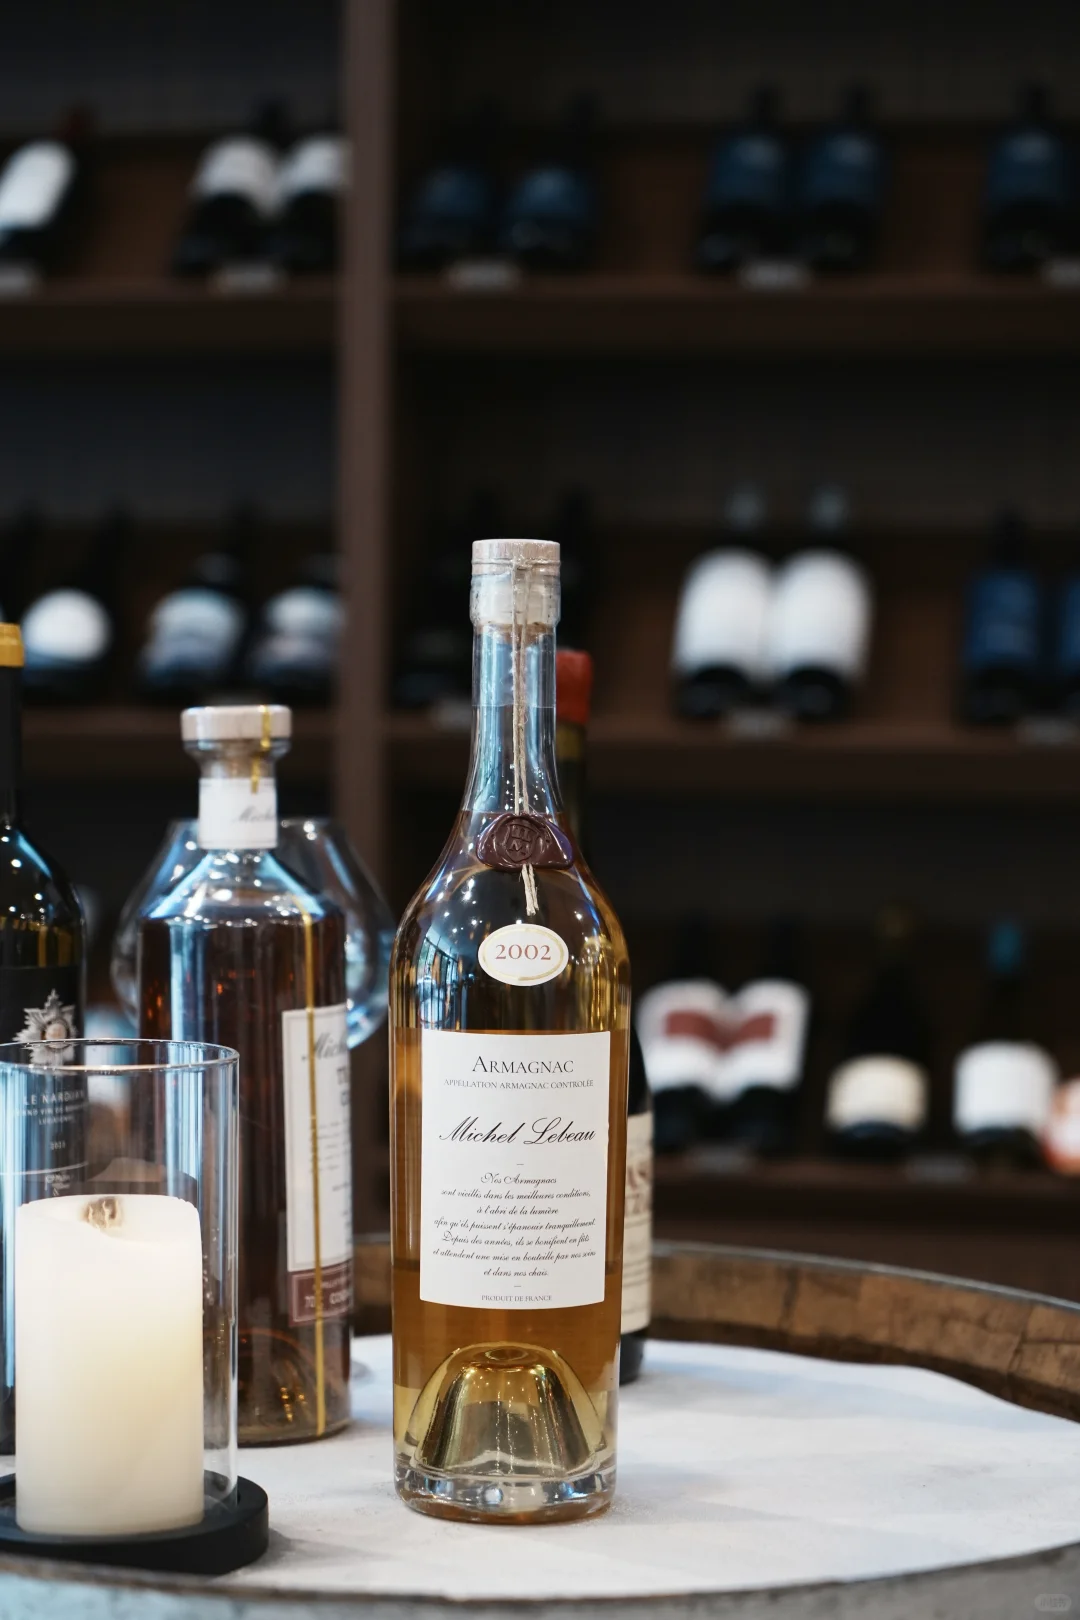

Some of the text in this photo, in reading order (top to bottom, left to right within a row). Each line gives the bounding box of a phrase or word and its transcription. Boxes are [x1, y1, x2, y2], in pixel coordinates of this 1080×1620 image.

[495, 944, 551, 960] 2002
[472, 1055, 574, 1074] ARMAGNAC
[499, 1081, 550, 1090] ARMAGNAC
[438, 1115, 596, 1145] Michel Lebeau
[480, 1172, 557, 1188] Nos Armagnacs
[441, 1188, 457, 1196] sont
[457, 1188, 482, 1199] vieillis
[483, 1189, 503, 1199] dans
[504, 1190, 514, 1200] les
[516, 1190, 554, 1200] meilleures
[476, 1205, 558, 1215] à l'abri de la lumière
[434, 1216, 448, 1229] afin
[449, 1218, 469, 1230] qu'ils
[469, 1221, 502, 1232] puissent
[503, 1222, 544, 1233] s'épanouir
[442, 1230, 469, 1245] Depuis
[471, 1235, 482, 1244] des
[484, 1238, 513, 1247] années,
[515, 1236, 525, 1246] ils
[535, 1234, 569, 1249] bonifient
[440, 1249, 475, 1259] attendent
[492, 1253, 510, 1261] mise
[523, 1250, 555, 1262] bouteille
[554, 1252, 569, 1264] par
[483, 1268, 492, 1276] et
[492, 1266, 512, 1277] dans
[481, 1294, 513, 1302] PRODUIT
